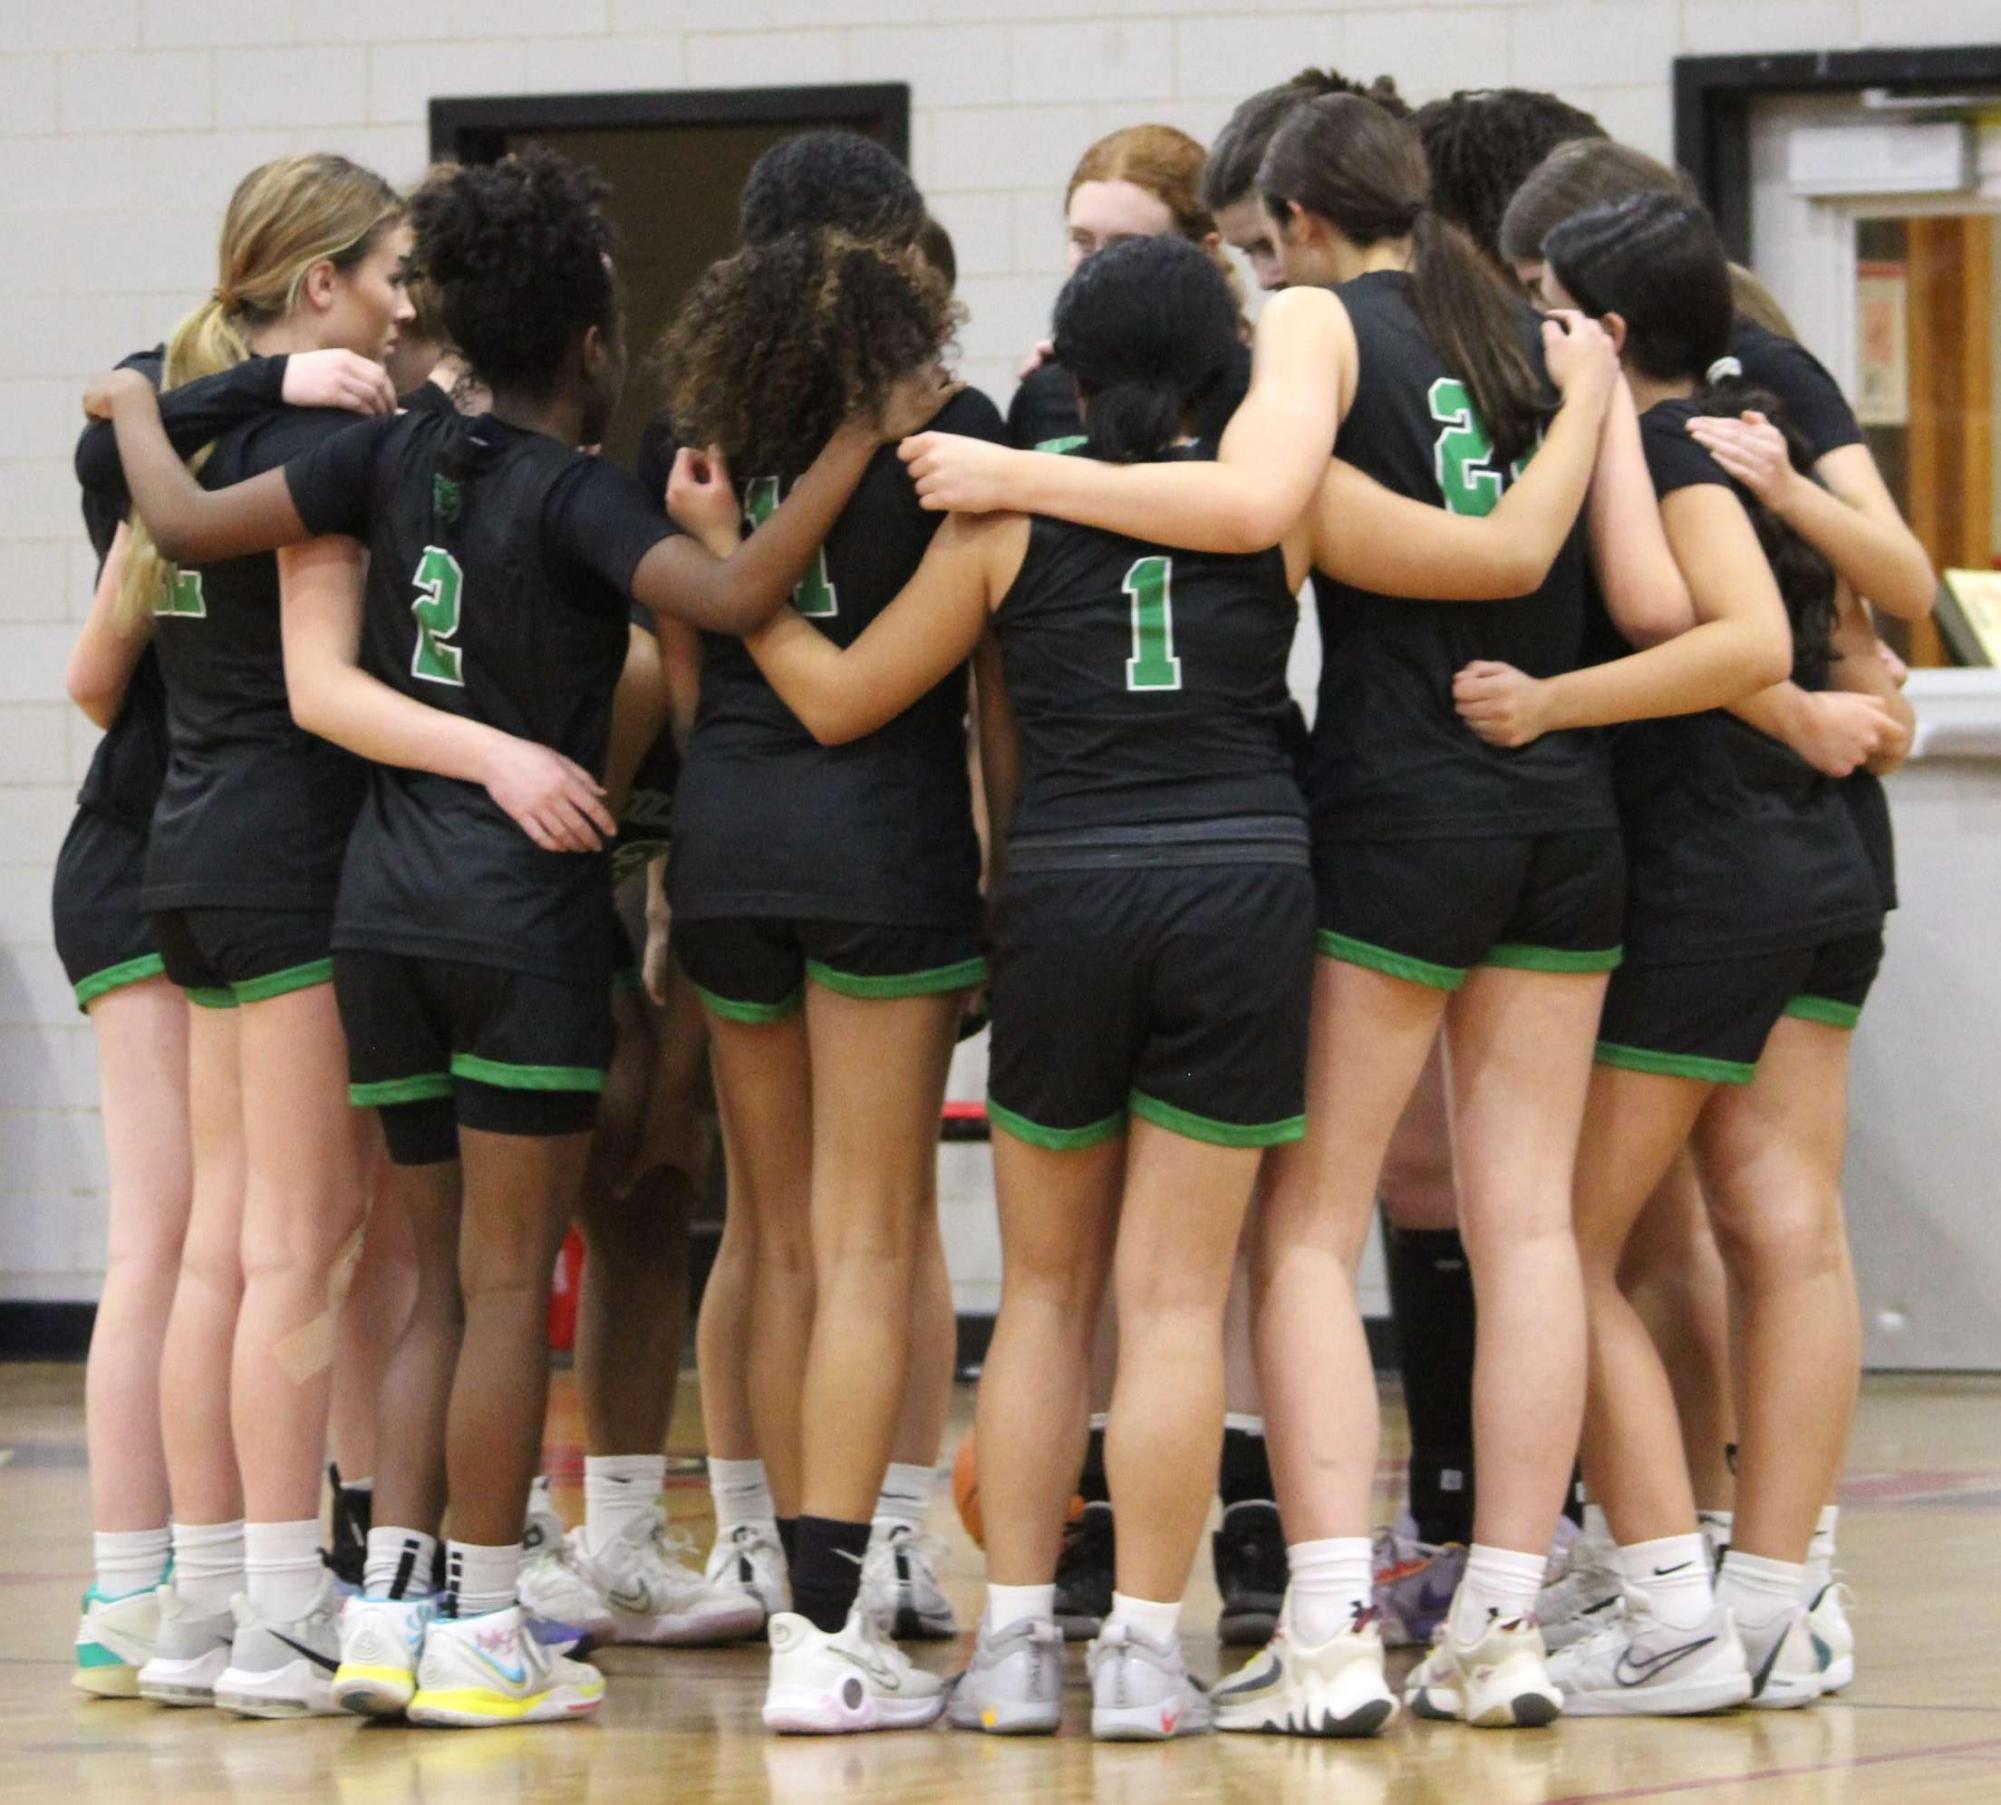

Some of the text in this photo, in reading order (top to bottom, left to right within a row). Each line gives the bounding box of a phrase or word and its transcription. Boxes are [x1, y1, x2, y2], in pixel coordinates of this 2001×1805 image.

[1428, 377, 1545, 517] 2
[411, 545, 465, 687] 2
[1121, 555, 1182, 691] 1
